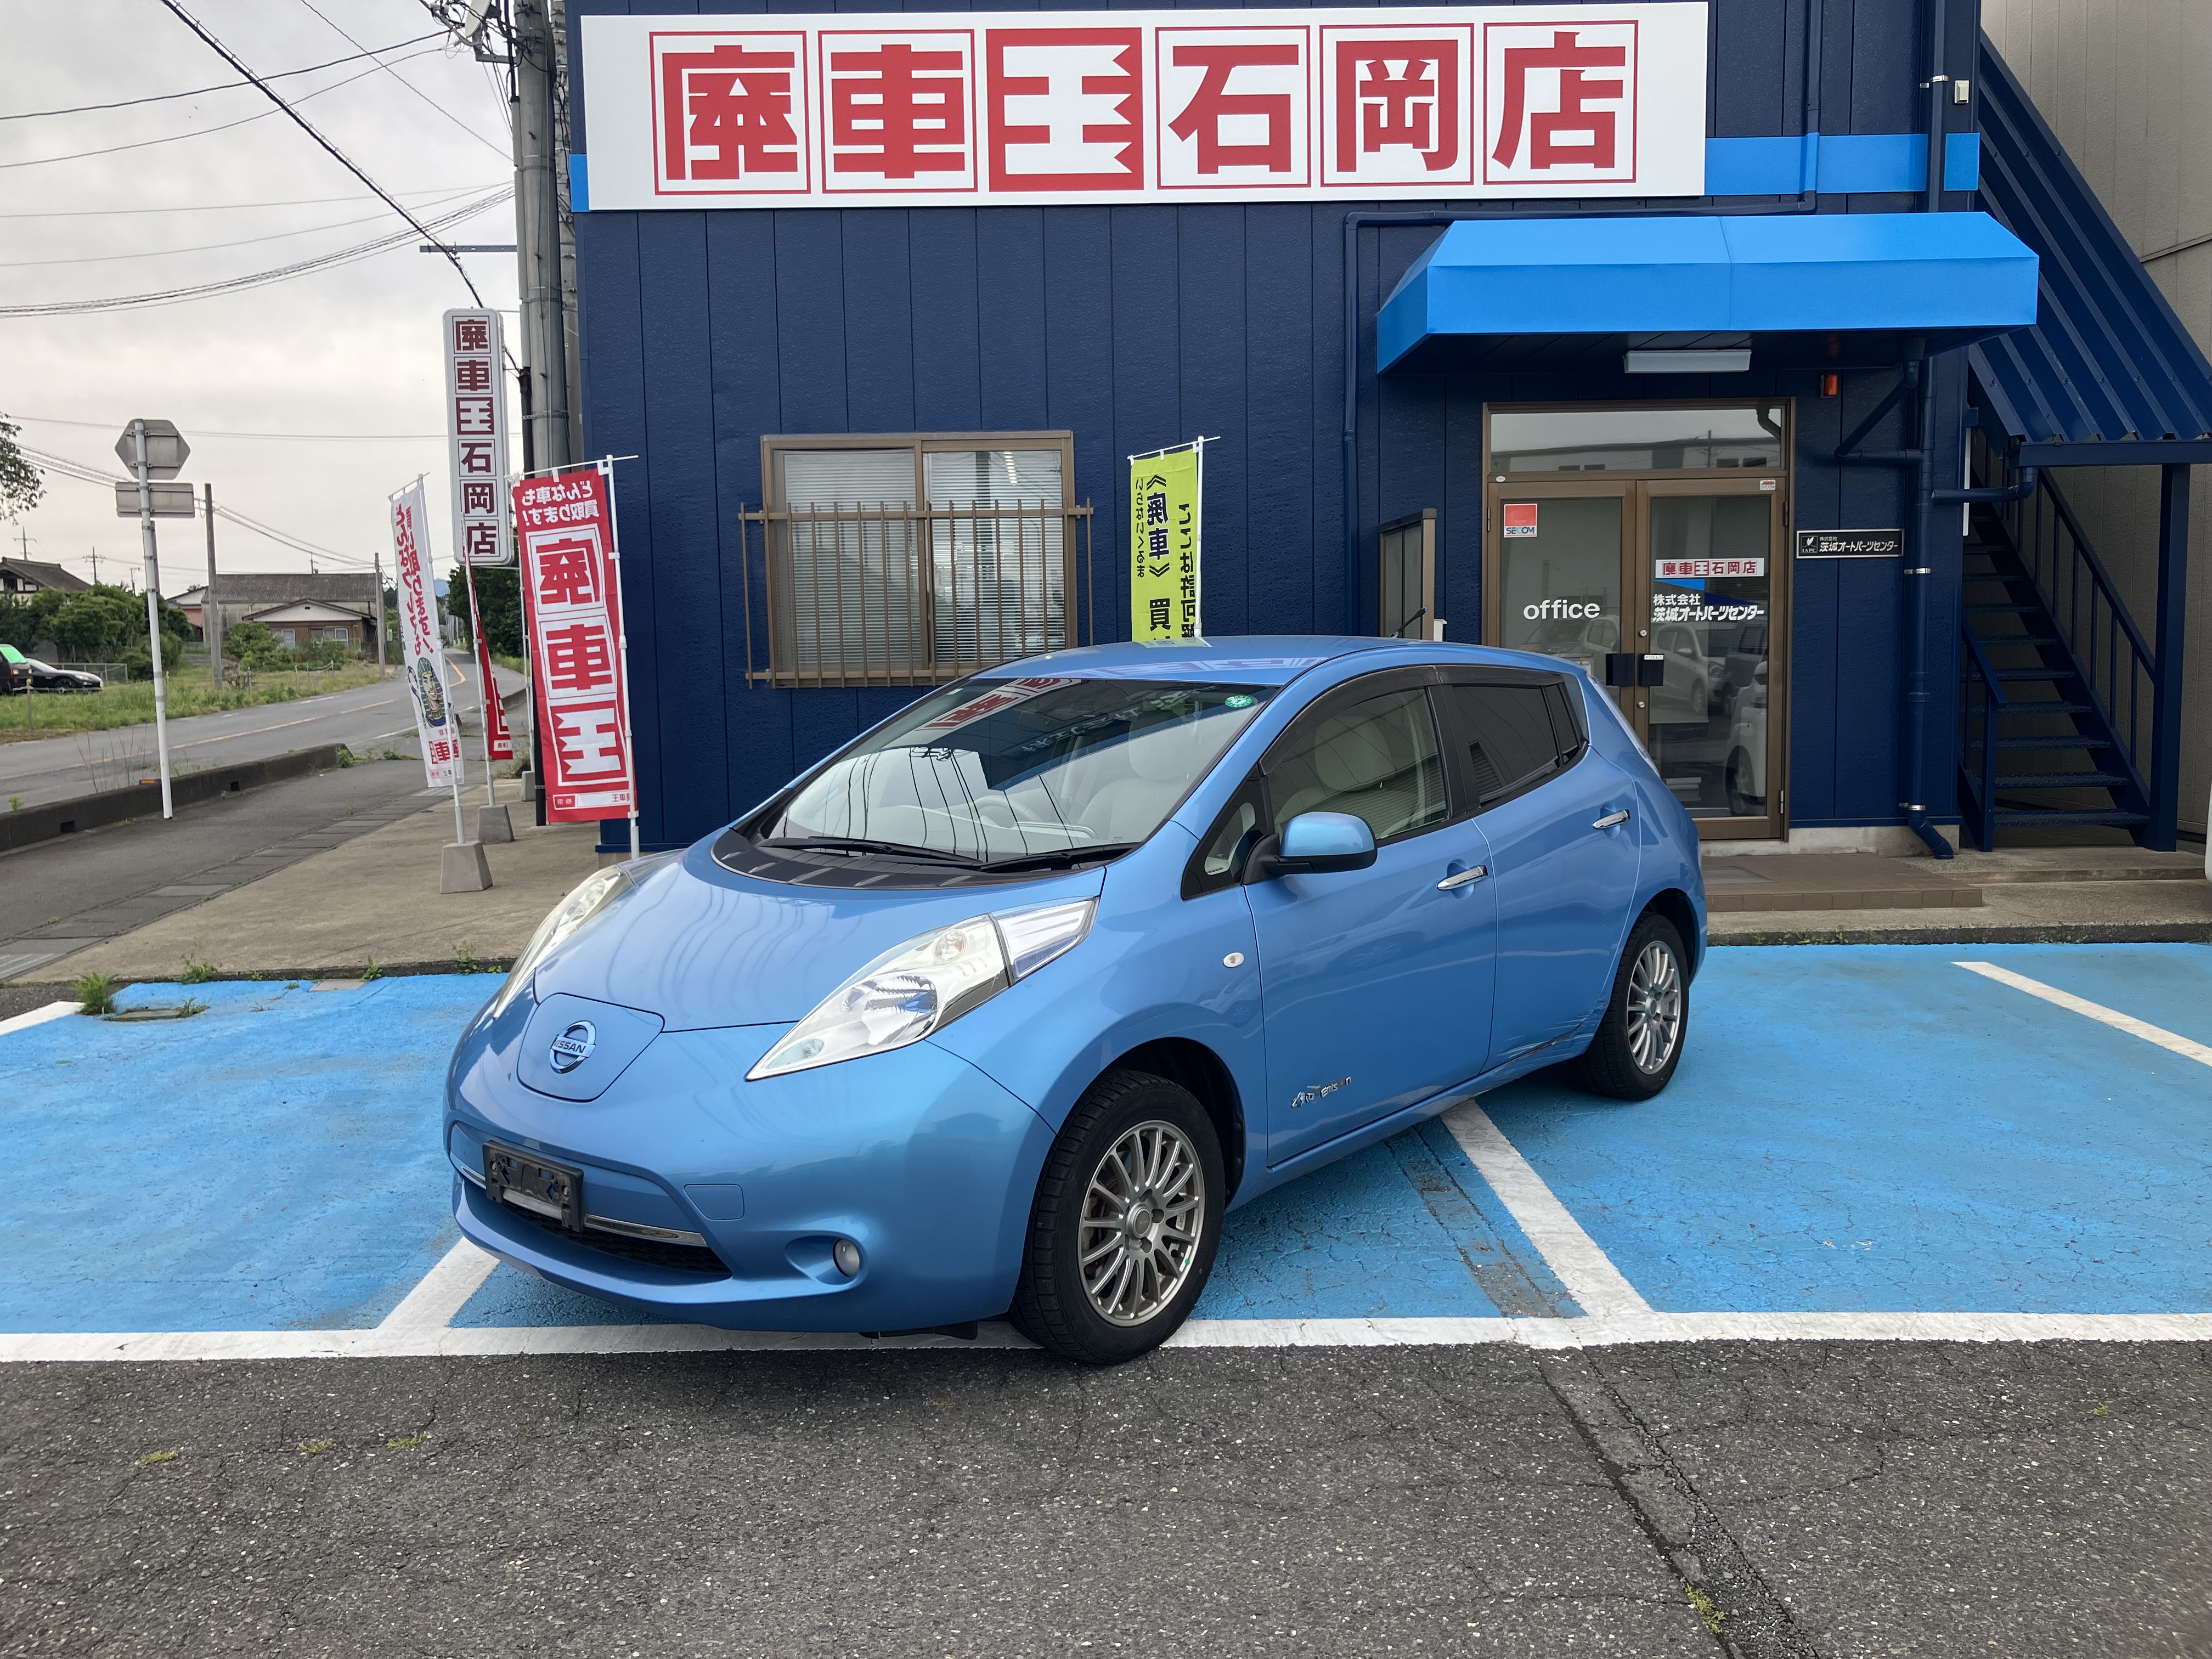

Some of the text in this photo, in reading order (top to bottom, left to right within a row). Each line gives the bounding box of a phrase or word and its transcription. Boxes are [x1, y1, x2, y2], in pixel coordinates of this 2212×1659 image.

[663, 26, 1626, 192] 廃車王石岡店
[455, 319, 500, 556] 廃車王石岡店
[1506, 526, 1534, 534] SECOM
[1819, 541, 1899, 552] 茨城オートパーツセンター
[1663, 561, 1756, 576] 廃車王石岡店
[1653, 594, 1701, 606] 株式会社
[1523, 600, 1600, 620] office
[1652, 605, 1764, 622] 茨城オートパーツセンター
[554, 1039, 586, 1054] NISSAN
